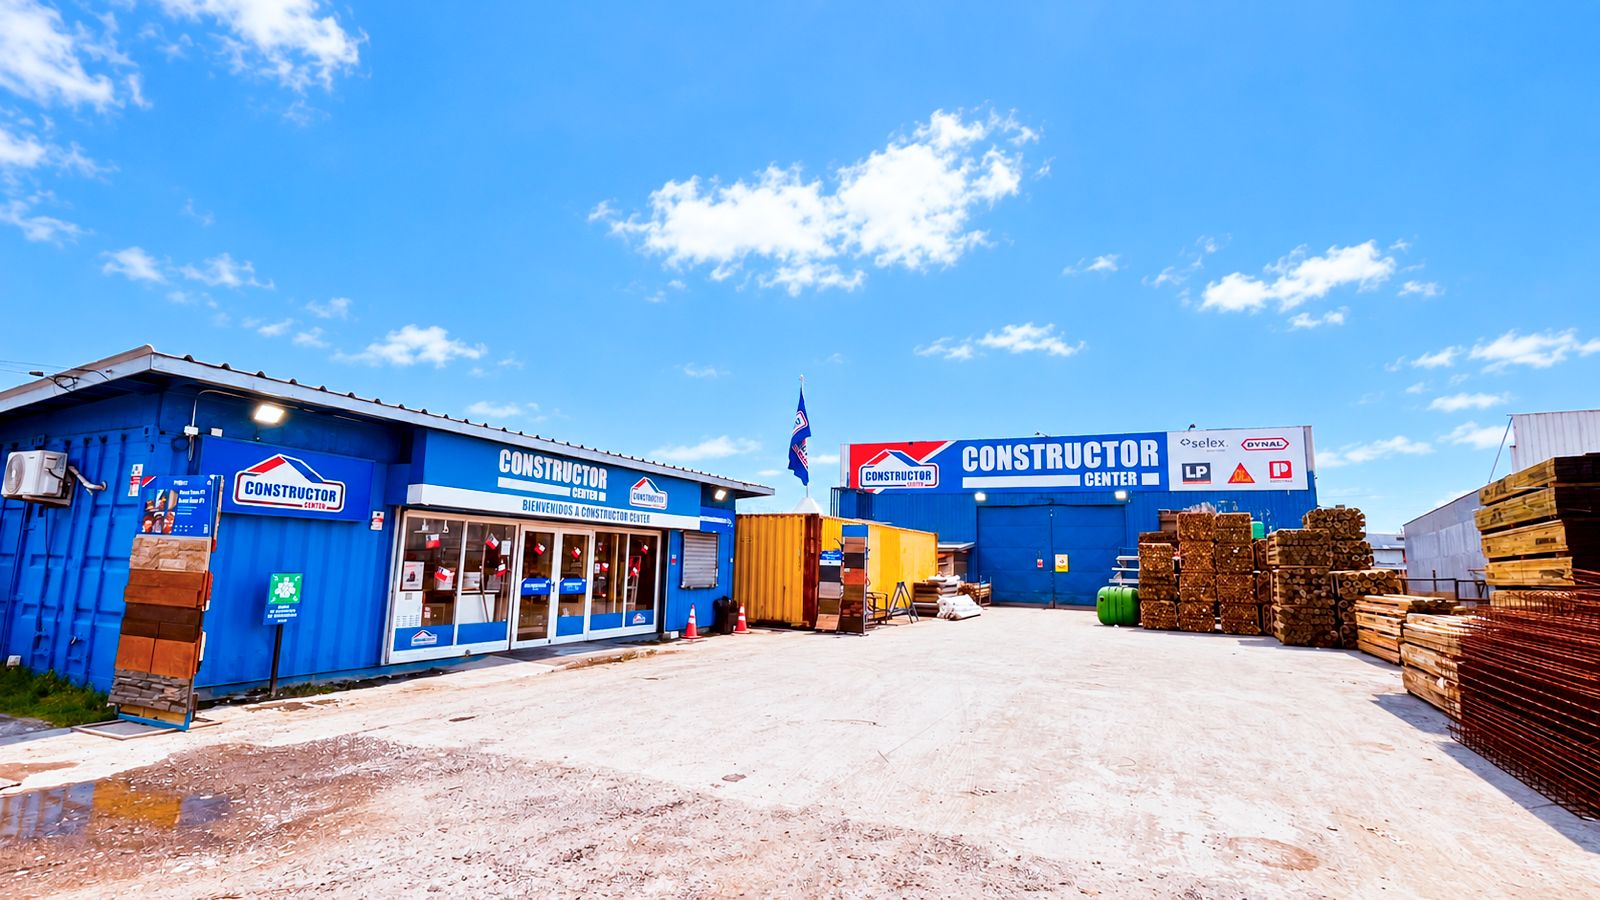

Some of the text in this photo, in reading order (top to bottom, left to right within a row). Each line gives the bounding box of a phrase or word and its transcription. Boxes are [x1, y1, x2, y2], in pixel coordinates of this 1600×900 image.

[1247, 440, 1283, 448] DYNAL
[962, 439, 1159, 472] CONSTRUCTOR
[498, 448, 608, 490] CONSTRUCTOR
[865, 470, 932, 482] CONSTRUCTOR
[1185, 465, 1208, 479] LP
[1084, 471, 1138, 487] CENTER
[244, 480, 337, 503] CONSTRUCTOR
[572, 486, 599, 501] CENTER
[303, 501, 327, 510] CENTER
[522, 499, 651, 524] BIENVENIDOS A CONSTRUCTOR CENTER
